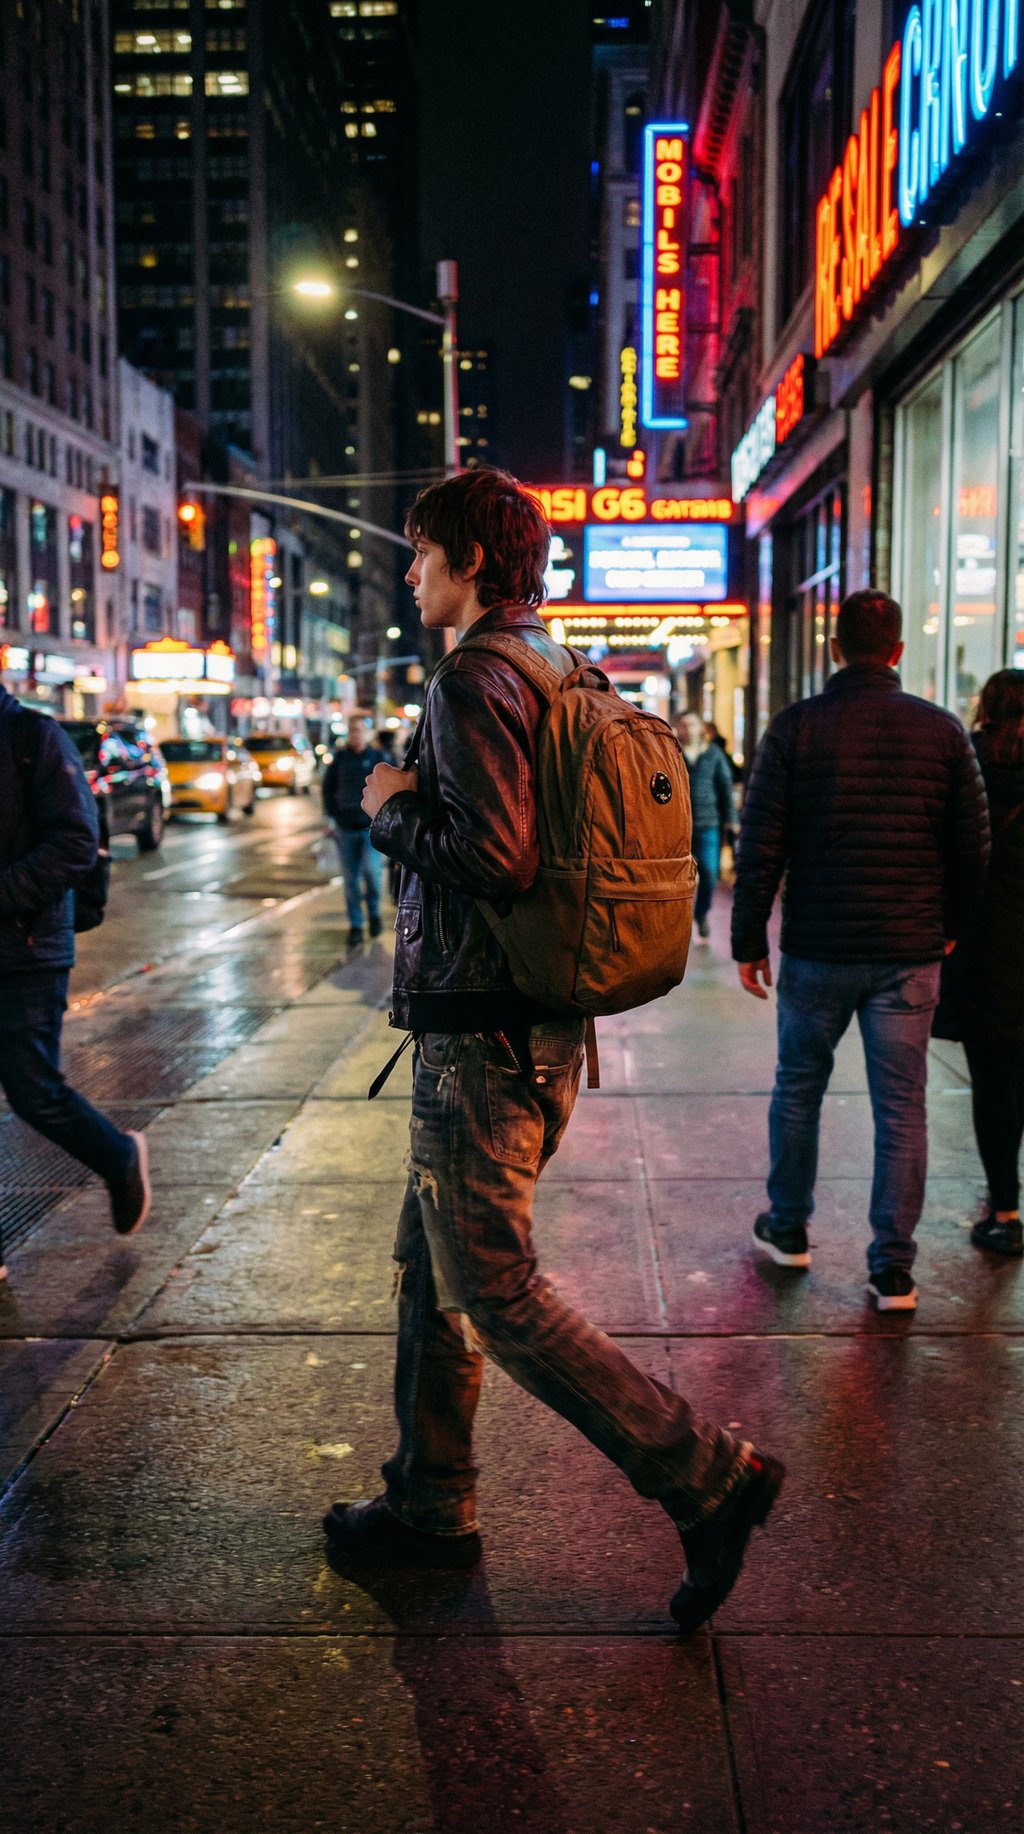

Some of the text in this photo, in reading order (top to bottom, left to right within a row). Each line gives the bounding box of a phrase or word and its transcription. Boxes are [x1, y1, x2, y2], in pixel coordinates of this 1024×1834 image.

[656, 138, 683, 379] MOBILS HERE
[591, 487, 647, 521] G6
